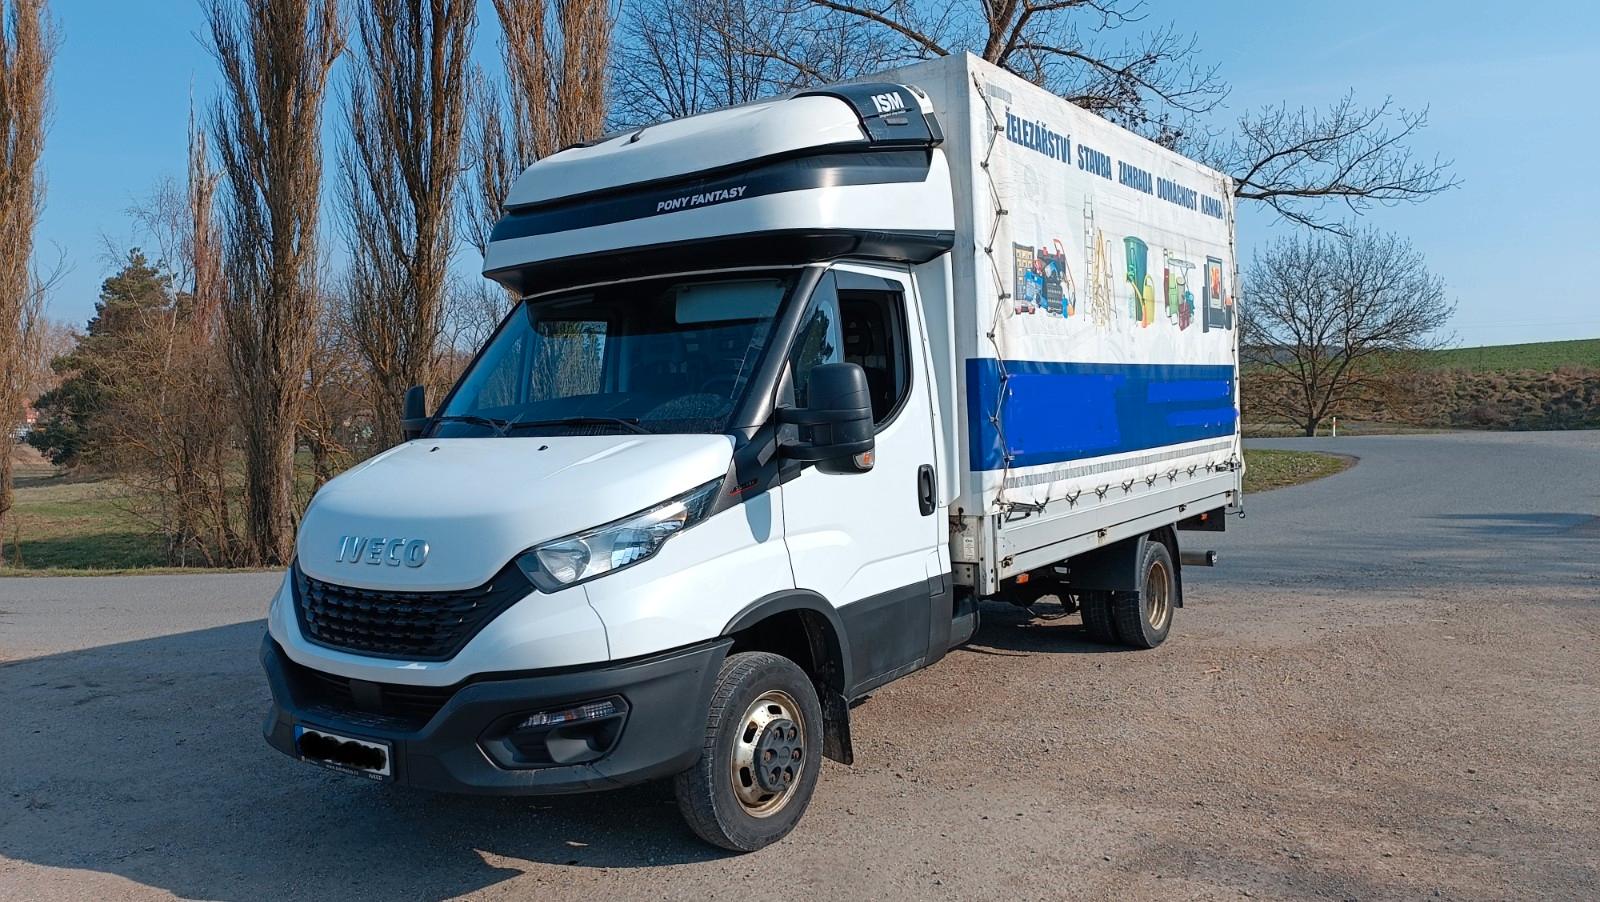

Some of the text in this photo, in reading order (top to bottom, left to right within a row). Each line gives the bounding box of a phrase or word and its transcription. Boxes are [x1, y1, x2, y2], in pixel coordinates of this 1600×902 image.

[871, 91, 905, 113] ISM
[1005, 105, 1071, 165] ŽELEZÁŘSTVÍ
[1077, 143, 1112, 181] STAVBA
[1118, 160, 1154, 196] ZAHRADA
[1157, 176, 1198, 212] DOMÁCNOST
[656, 185, 747, 212] PONY FANTASY
[336, 535, 430, 568] IVECO
